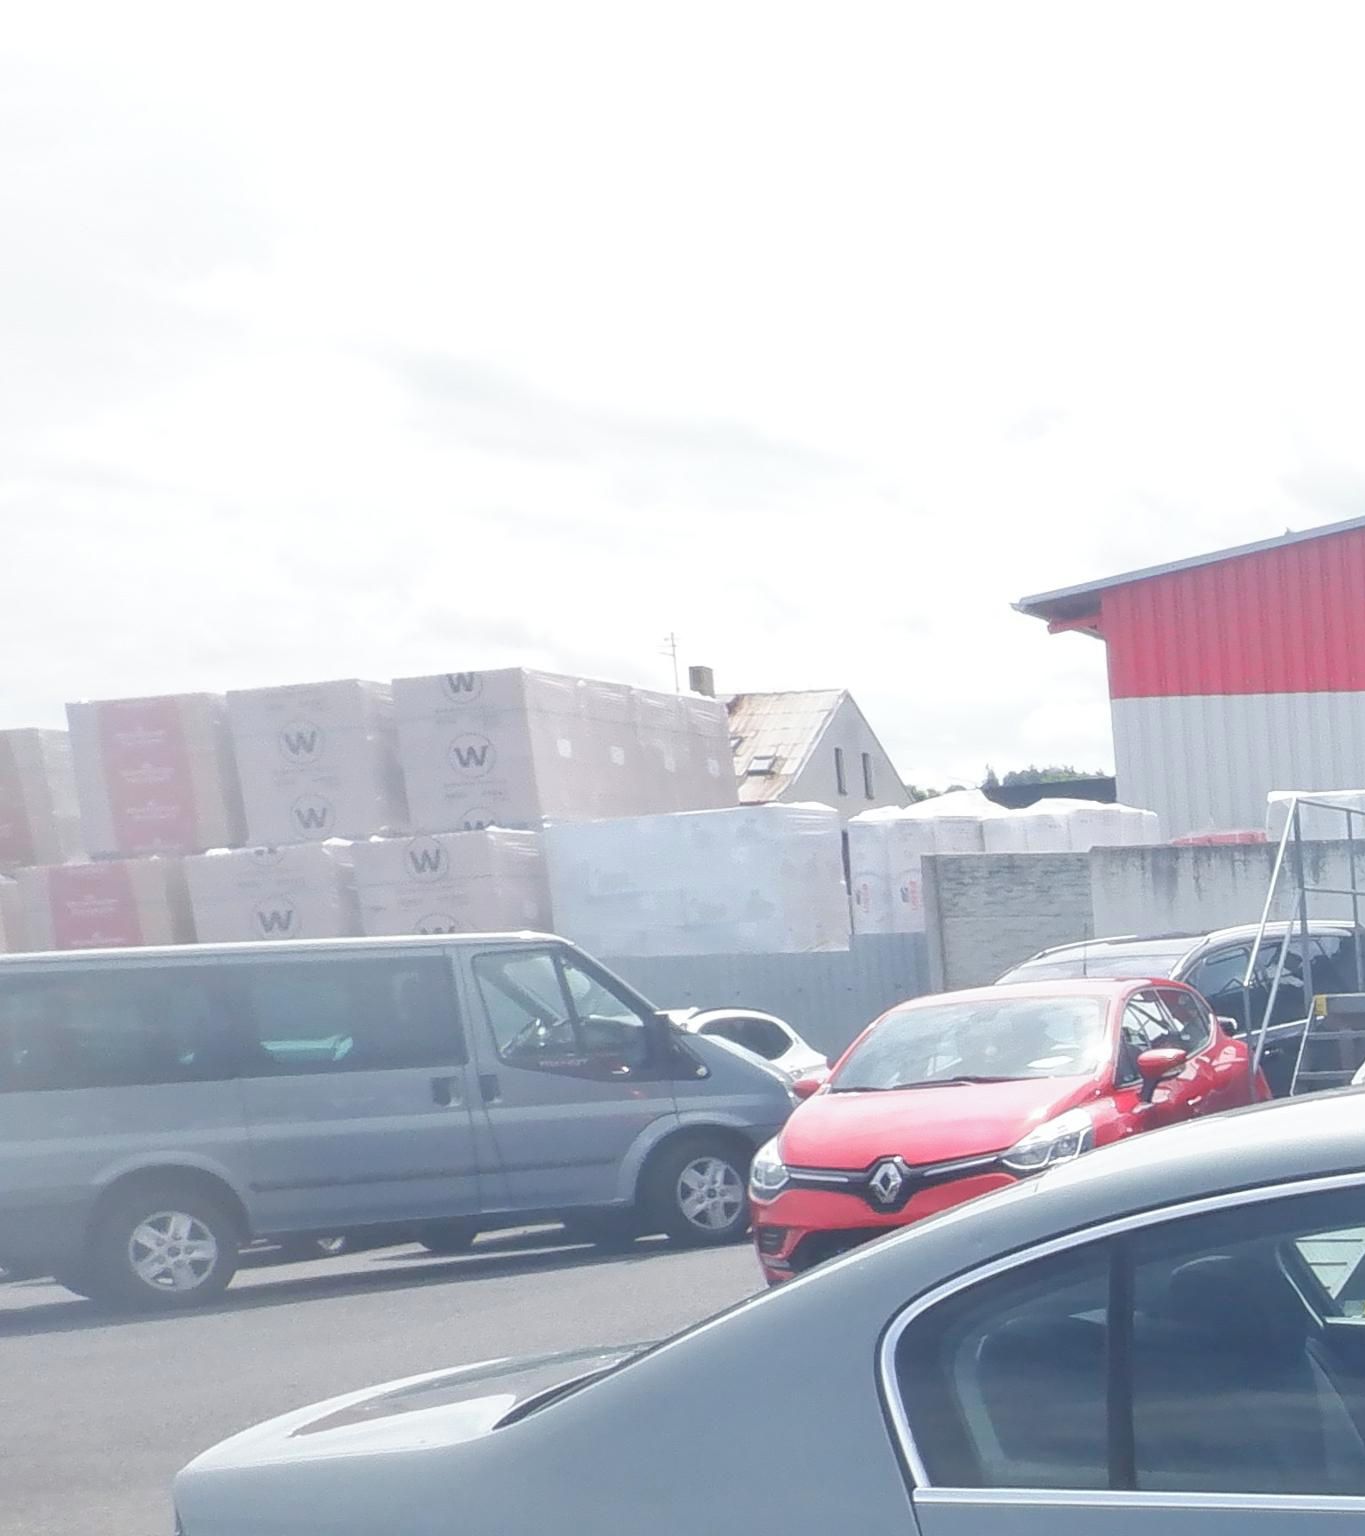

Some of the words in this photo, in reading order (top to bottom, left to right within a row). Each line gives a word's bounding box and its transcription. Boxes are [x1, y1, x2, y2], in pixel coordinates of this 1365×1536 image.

[284, 730, 317, 756] W
[453, 744, 489, 769] W
[293, 806, 328, 830] W
[409, 848, 441, 874] W
[256, 909, 294, 934] W
